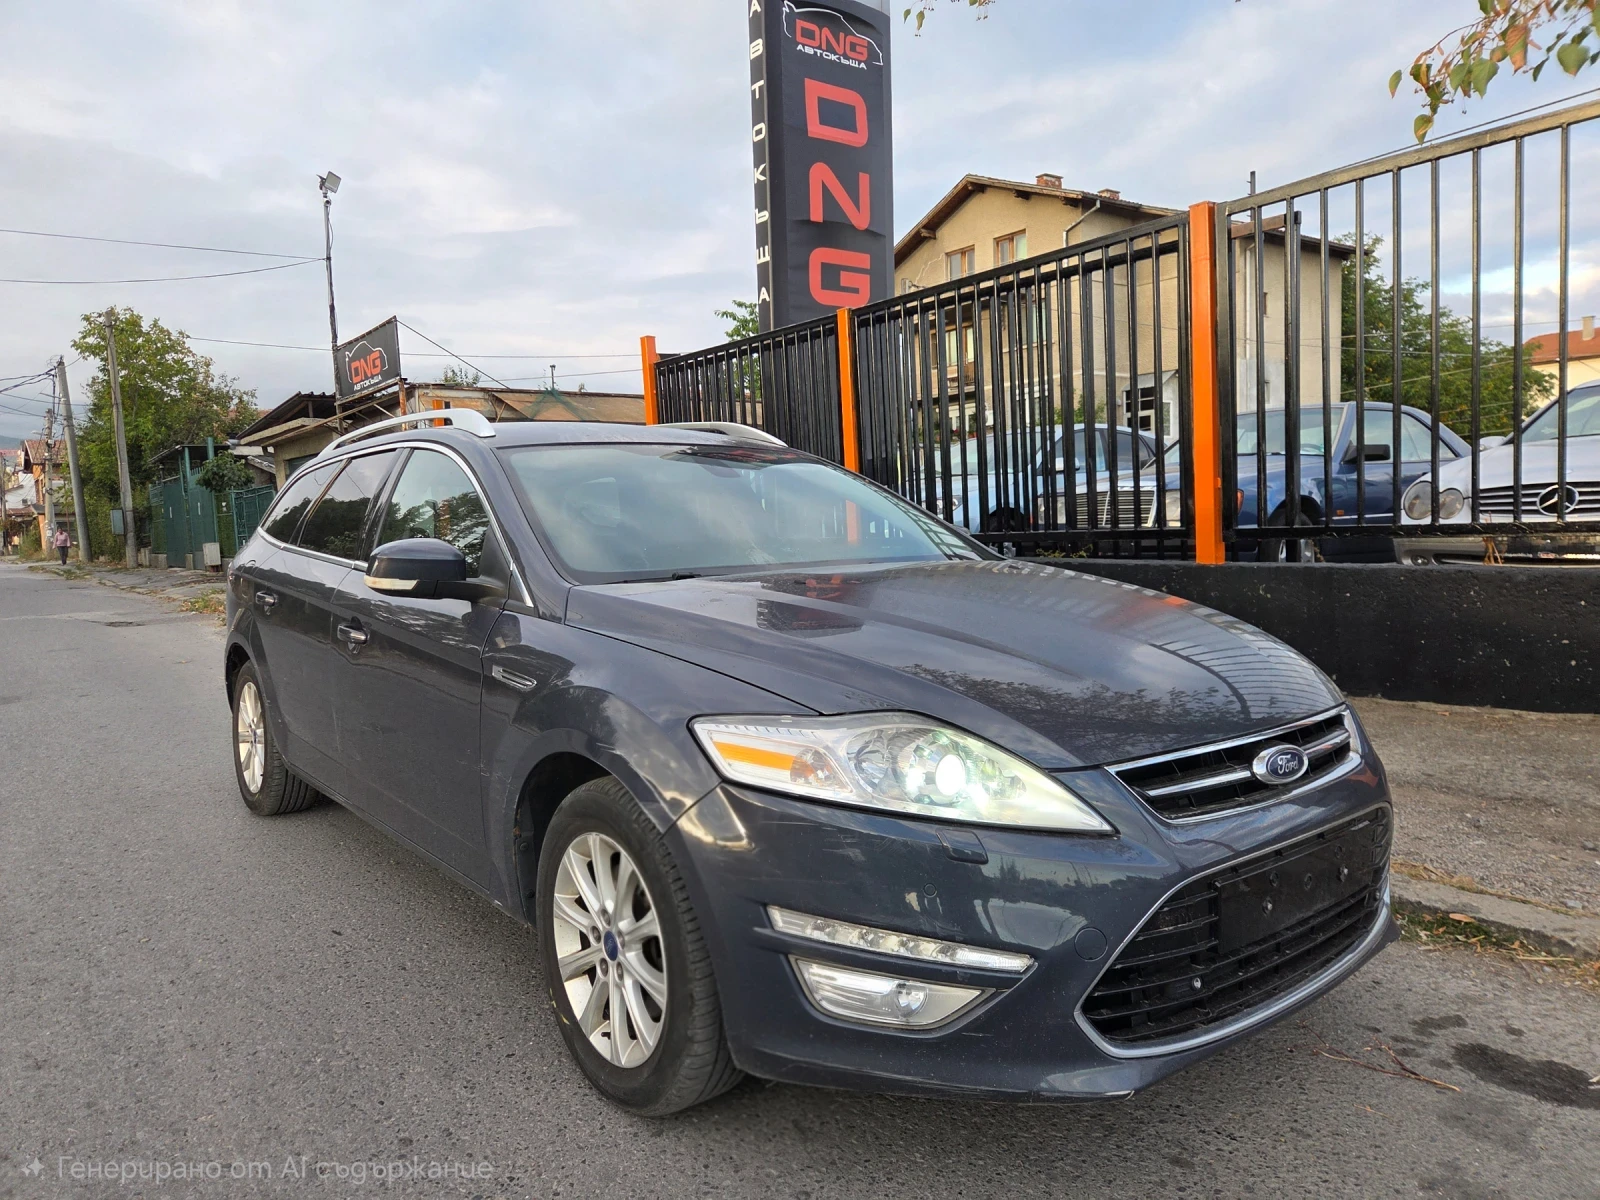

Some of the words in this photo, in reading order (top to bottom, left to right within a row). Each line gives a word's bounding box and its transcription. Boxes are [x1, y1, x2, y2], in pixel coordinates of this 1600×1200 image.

[795, 18, 868, 61] DNG
[804, 77, 871, 308] DNG
[351, 350, 381, 383] DNG
[1277, 754, 1299, 774] Ford
